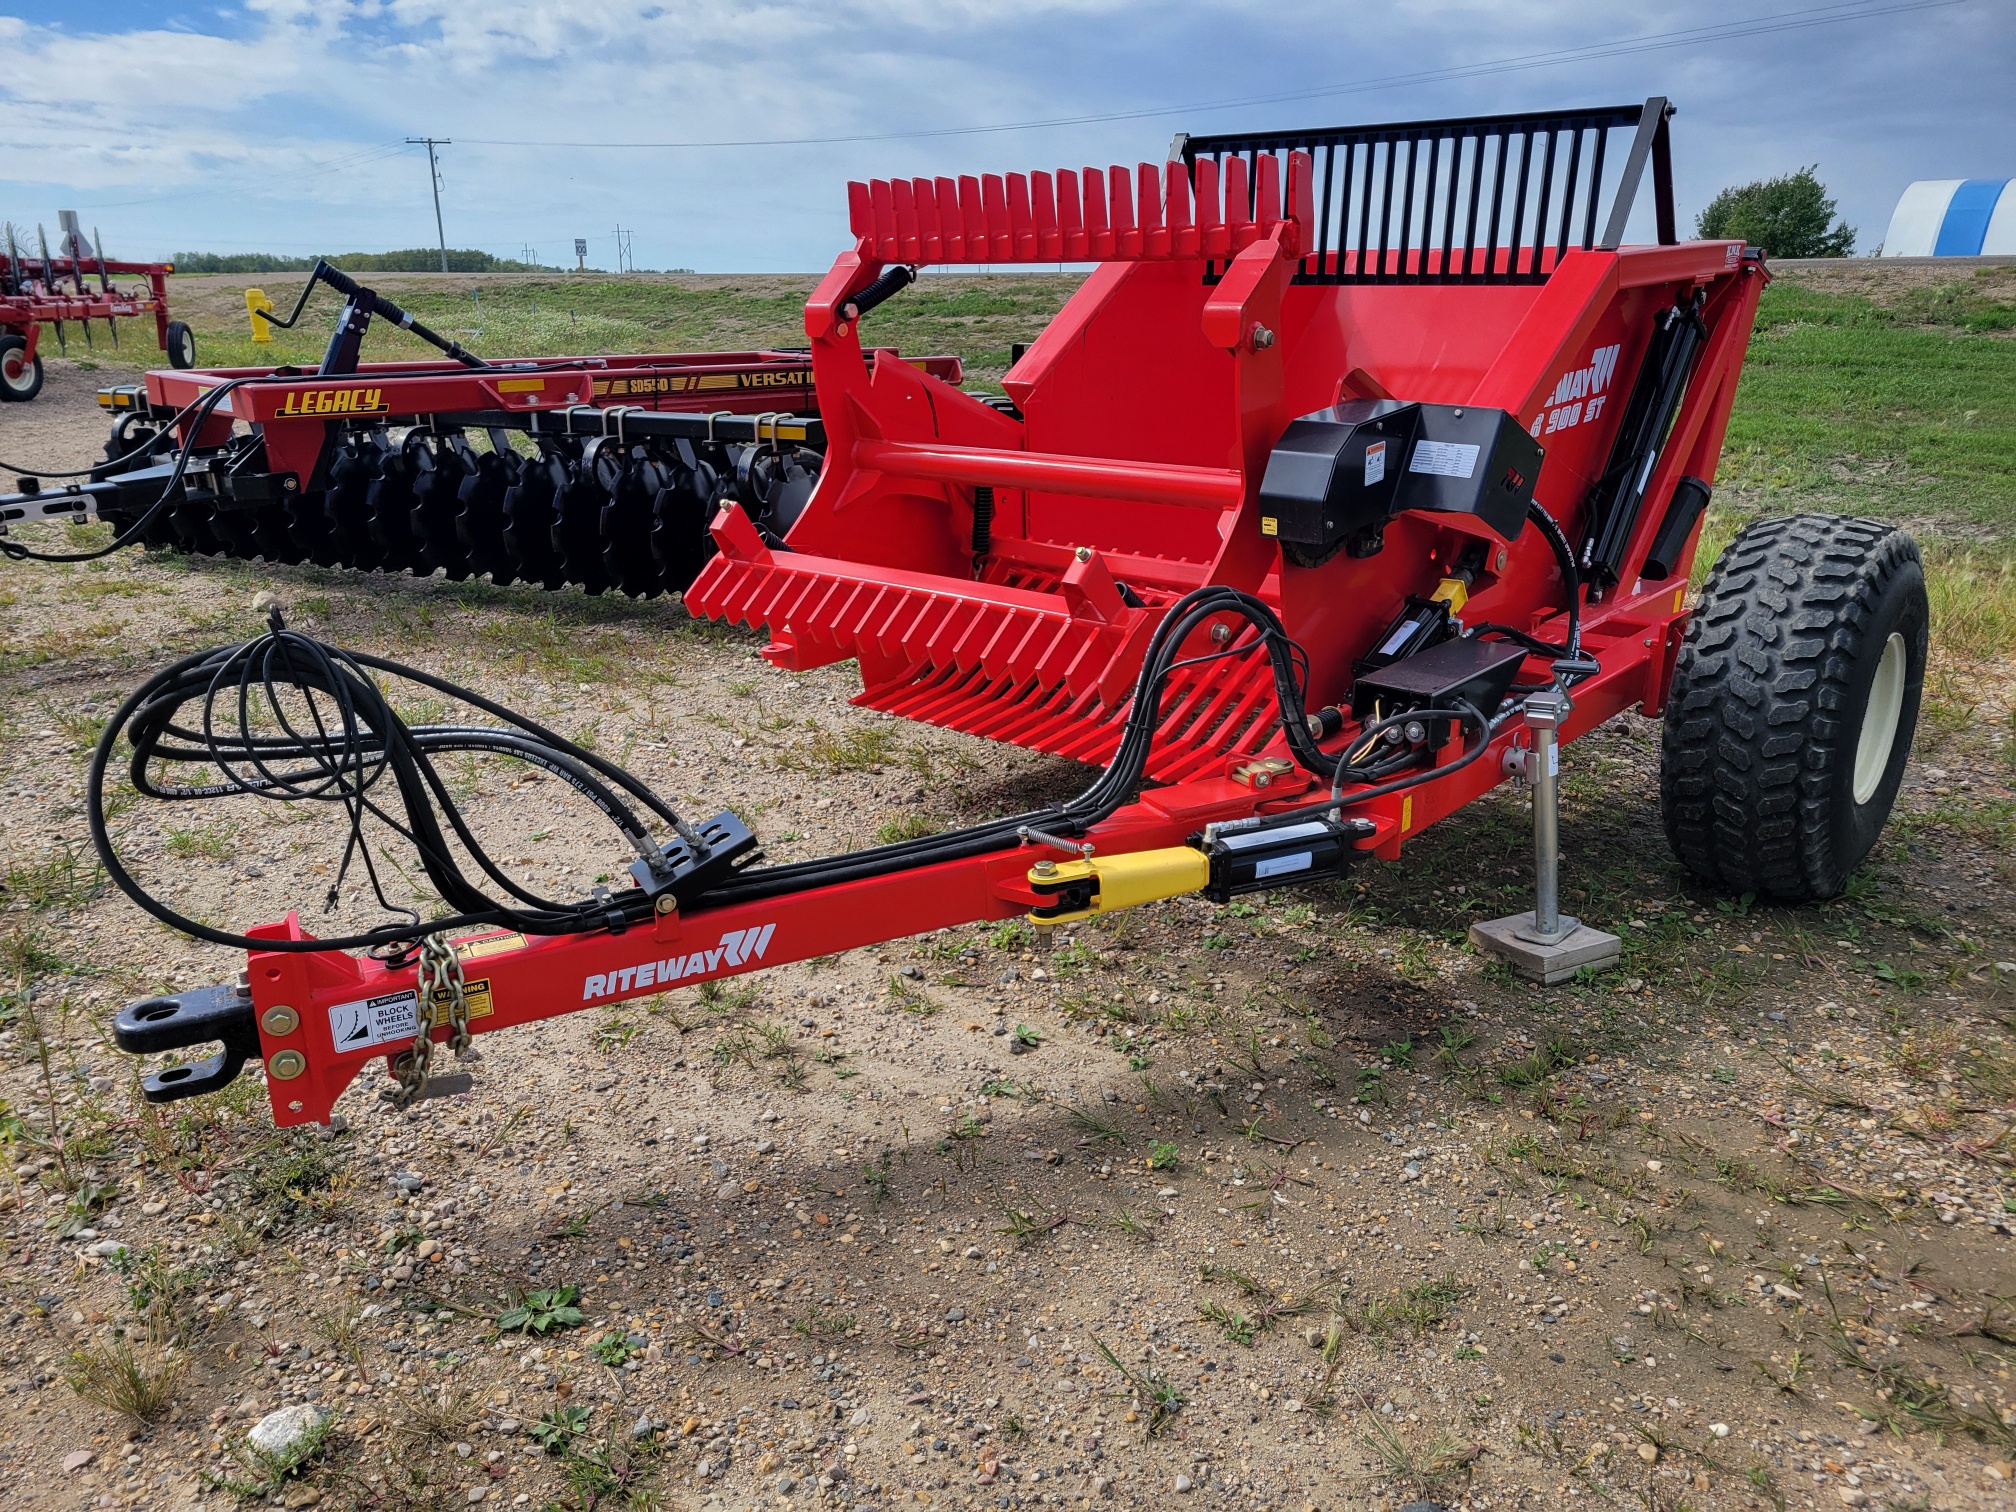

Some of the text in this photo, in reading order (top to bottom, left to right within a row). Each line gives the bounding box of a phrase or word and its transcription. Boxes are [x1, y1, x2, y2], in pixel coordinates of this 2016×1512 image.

[576, 246, 587, 254] 100
[630, 378, 668, 393] SD550
[285, 389, 381, 414] LEGACY
[1529, 395, 1606, 438] R 900 ST
[226, 779, 275, 793] PULAR
[571, 777, 583, 789] 275
[586, 790, 597, 801] PSI
[583, 946, 725, 1000] RITEWAY
[437, 983, 485, 999] WANING
[377, 992, 414, 1006] IMPORTANT
[378, 1004, 409, 1018] BLOCK
[375, 1012, 414, 1026] WHEELS
[376, 1025, 417, 1038] UNHOOKING
[383, 1022, 409, 1032] BEFORE
